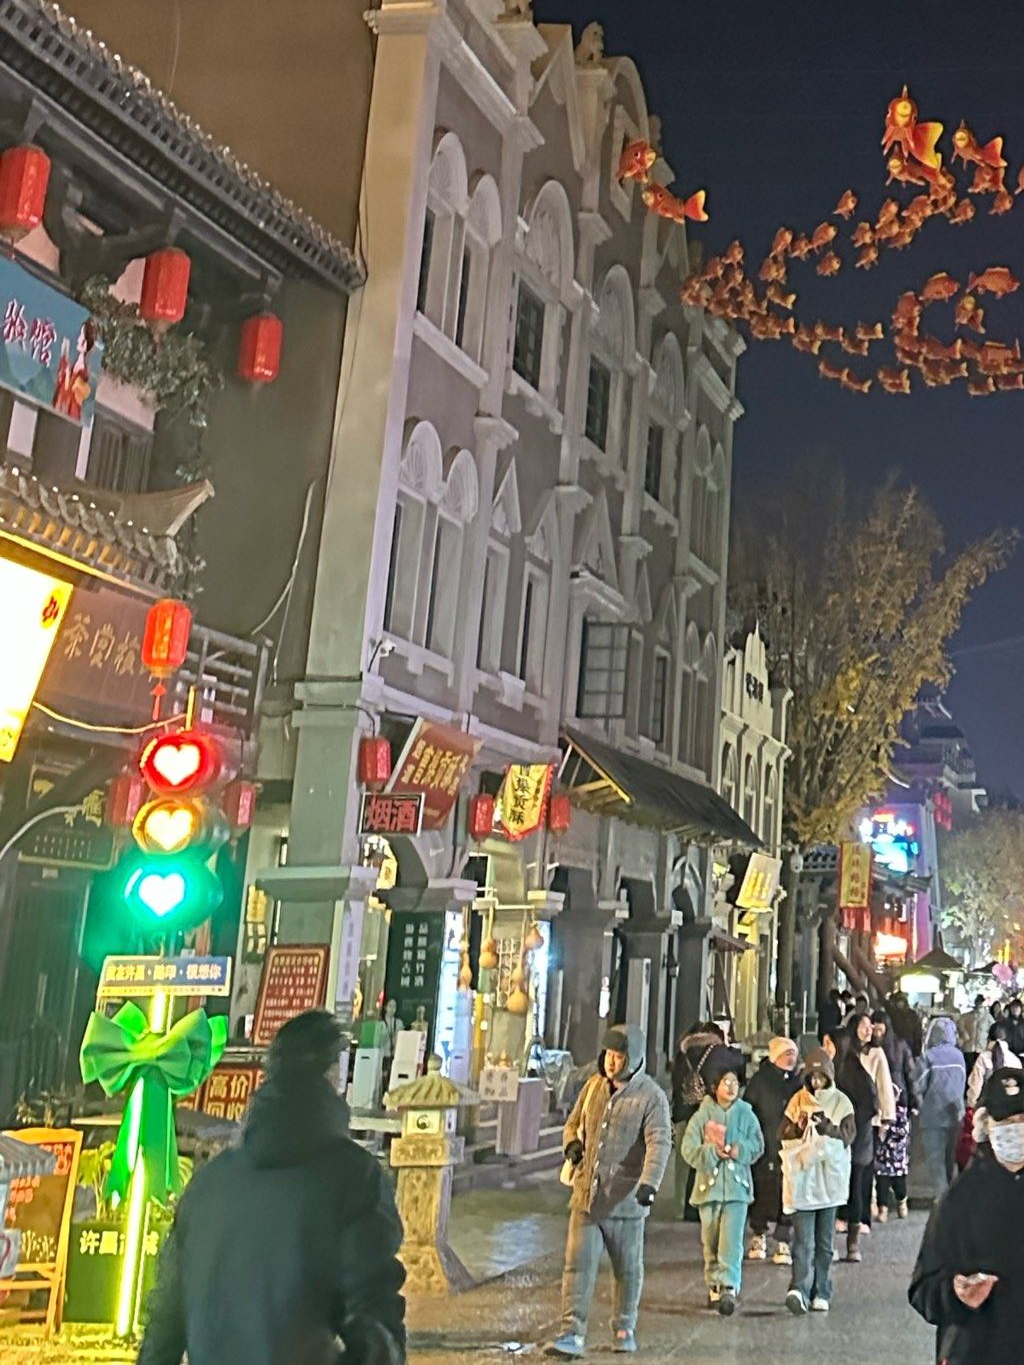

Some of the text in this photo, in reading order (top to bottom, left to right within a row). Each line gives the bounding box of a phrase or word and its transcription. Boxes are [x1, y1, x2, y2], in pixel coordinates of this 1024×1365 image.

[364, 797, 417, 832] 烟酒
[209, 1075, 248, 1098] 高价
[80, 1230, 159, 1255] 许昌城
